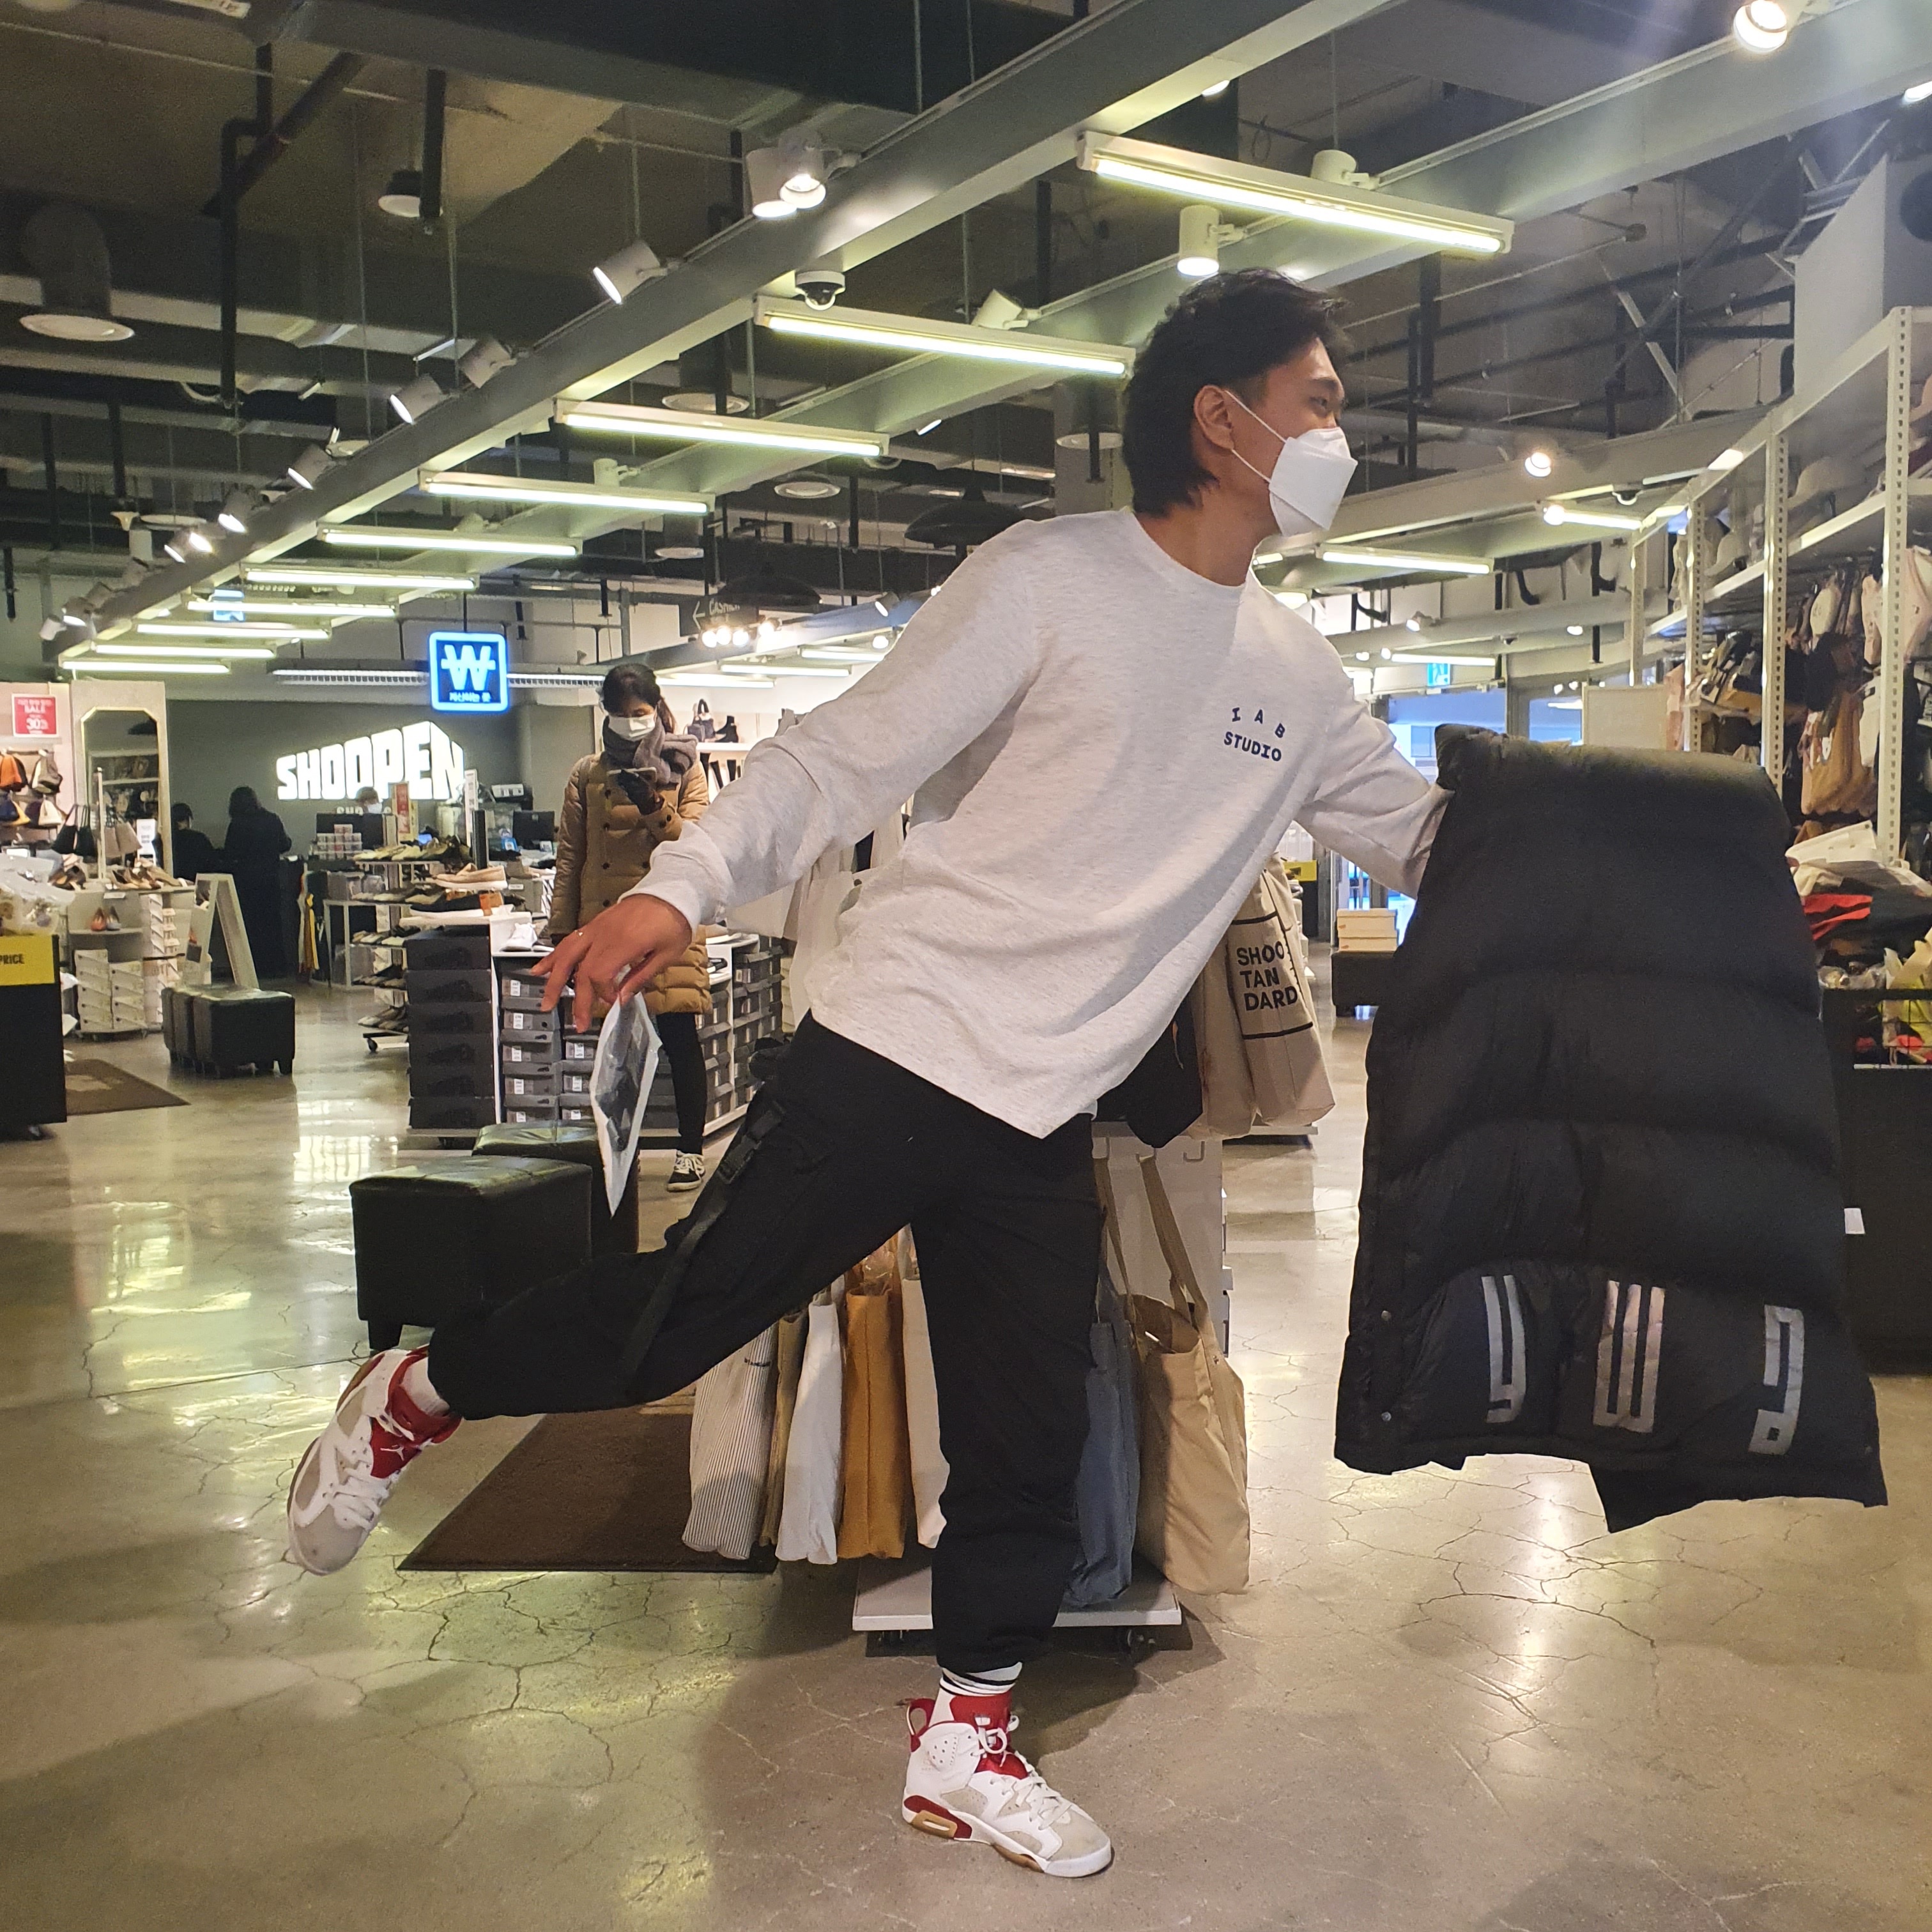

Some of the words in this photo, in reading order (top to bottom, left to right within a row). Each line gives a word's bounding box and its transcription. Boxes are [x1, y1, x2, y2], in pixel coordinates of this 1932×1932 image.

[277, 721, 464, 799] SHOOPEN
[1224, 732, 1282, 762] STUDIO
[1240, 967, 1280, 988] TAN
[1245, 986, 1298, 1011] DARD
